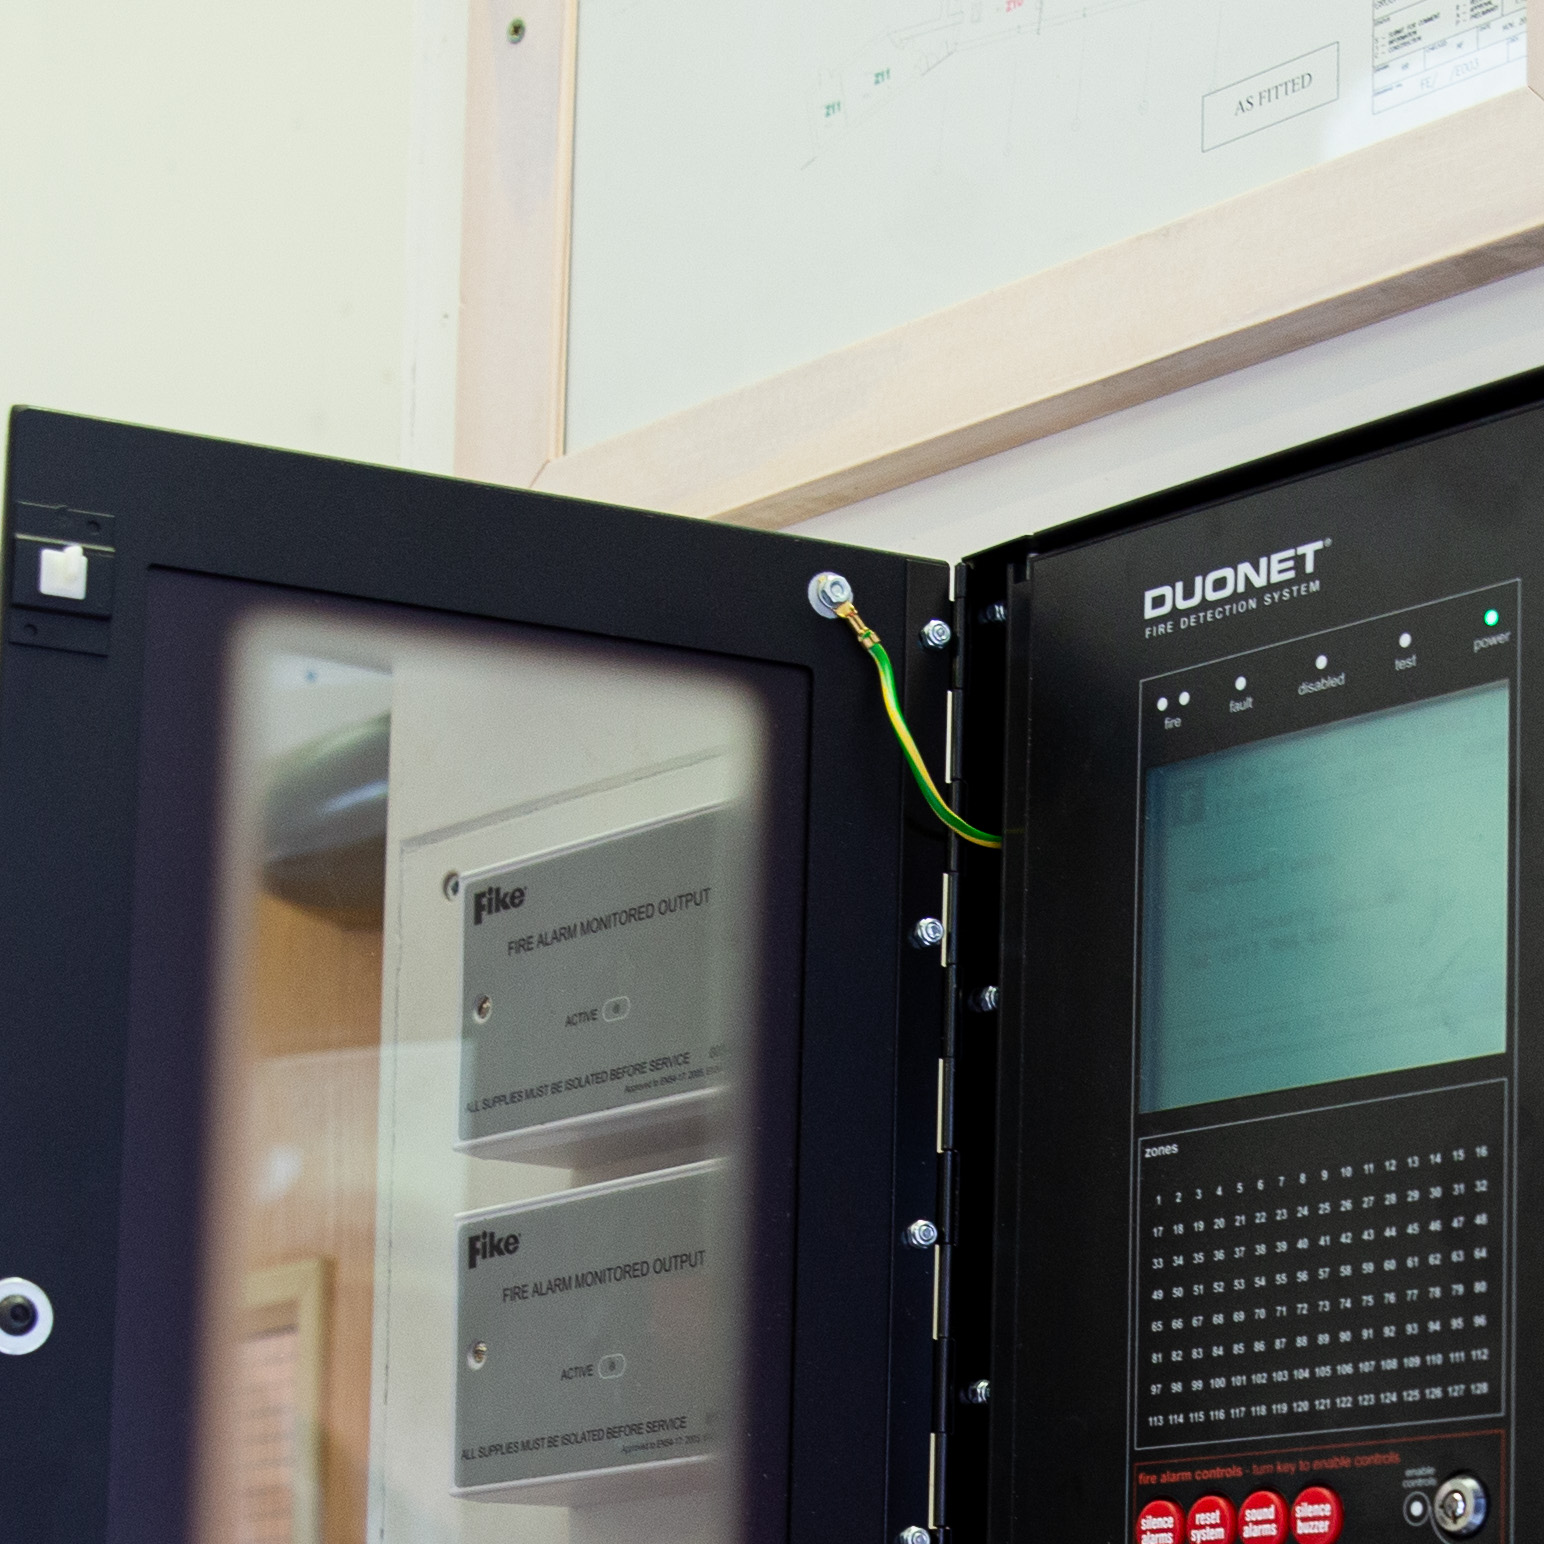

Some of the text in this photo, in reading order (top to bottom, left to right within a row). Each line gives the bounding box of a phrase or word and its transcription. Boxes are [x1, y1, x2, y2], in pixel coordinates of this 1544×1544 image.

[1234, 72, 1313, 117] AS FITTED
[1144, 540, 1323, 620] DUONET
[1144, 579, 1321, 640] FIRE DETECTION SYSTEM
[1472, 630, 1511, 653] power
[1394, 653, 1417, 672] test
[1297, 672, 1346, 697] disabled
[1229, 696, 1254, 714] fault
[1164, 715, 1182, 730] fire
[473, 885, 526, 926] Fike
[507, 887, 712, 956] FIRE ALARM MONITORED OUTPUT
[564, 1007, 598, 1028] ACTIVE
[482, 1089, 524, 1112] SUPPLIES
[524, 1083, 551, 1104] MUST
[550, 1080, 563, 1096] BE
[563, 1070, 608, 1094] ISOLATED
[608, 1059, 648, 1083] BEFORE
[648, 1051, 690, 1073] SERVICE
[1144, 1142, 1179, 1159] zones
[1156, 1146, 1488, 1205] 1 2 3 4 5 6 7 8 9 10 11 12 13 14 15 16
[467, 1229, 521, 1270] Fike
[502, 1250, 706, 1303] FIRE ALARM MONITORED OUTPUT
[560, 1364, 594, 1382] ACTIVE
[461, 1446, 478, 1461] ALL
[478, 1439, 519, 1458] SUPPLIES
[519, 1436, 545, 1453] MUST
[547, 1434, 559, 1449] BE
[560, 1427, 605, 1448] ISOLATED
[606, 1420, 644, 1440] BEFORE
[645, 1415, 687, 1434] SERVICE
[1138, 1452, 1401, 1485] fire alarm controls turn key to enable controls
[1404, 1465, 1436, 1478] enable
[1402, 1476, 1437, 1489] controls
[1195, 1509, 1220, 1525] reset
[1244, 1504, 1275, 1522] sound
[1295, 1502, 1331, 1518] silence
[1140, 1515, 1174, 1531] silence
[1242, 1522, 1277, 1538] alarms
[1296, 1519, 1330, 1535] buzzer
[1190, 1526, 1225, 1544] system
